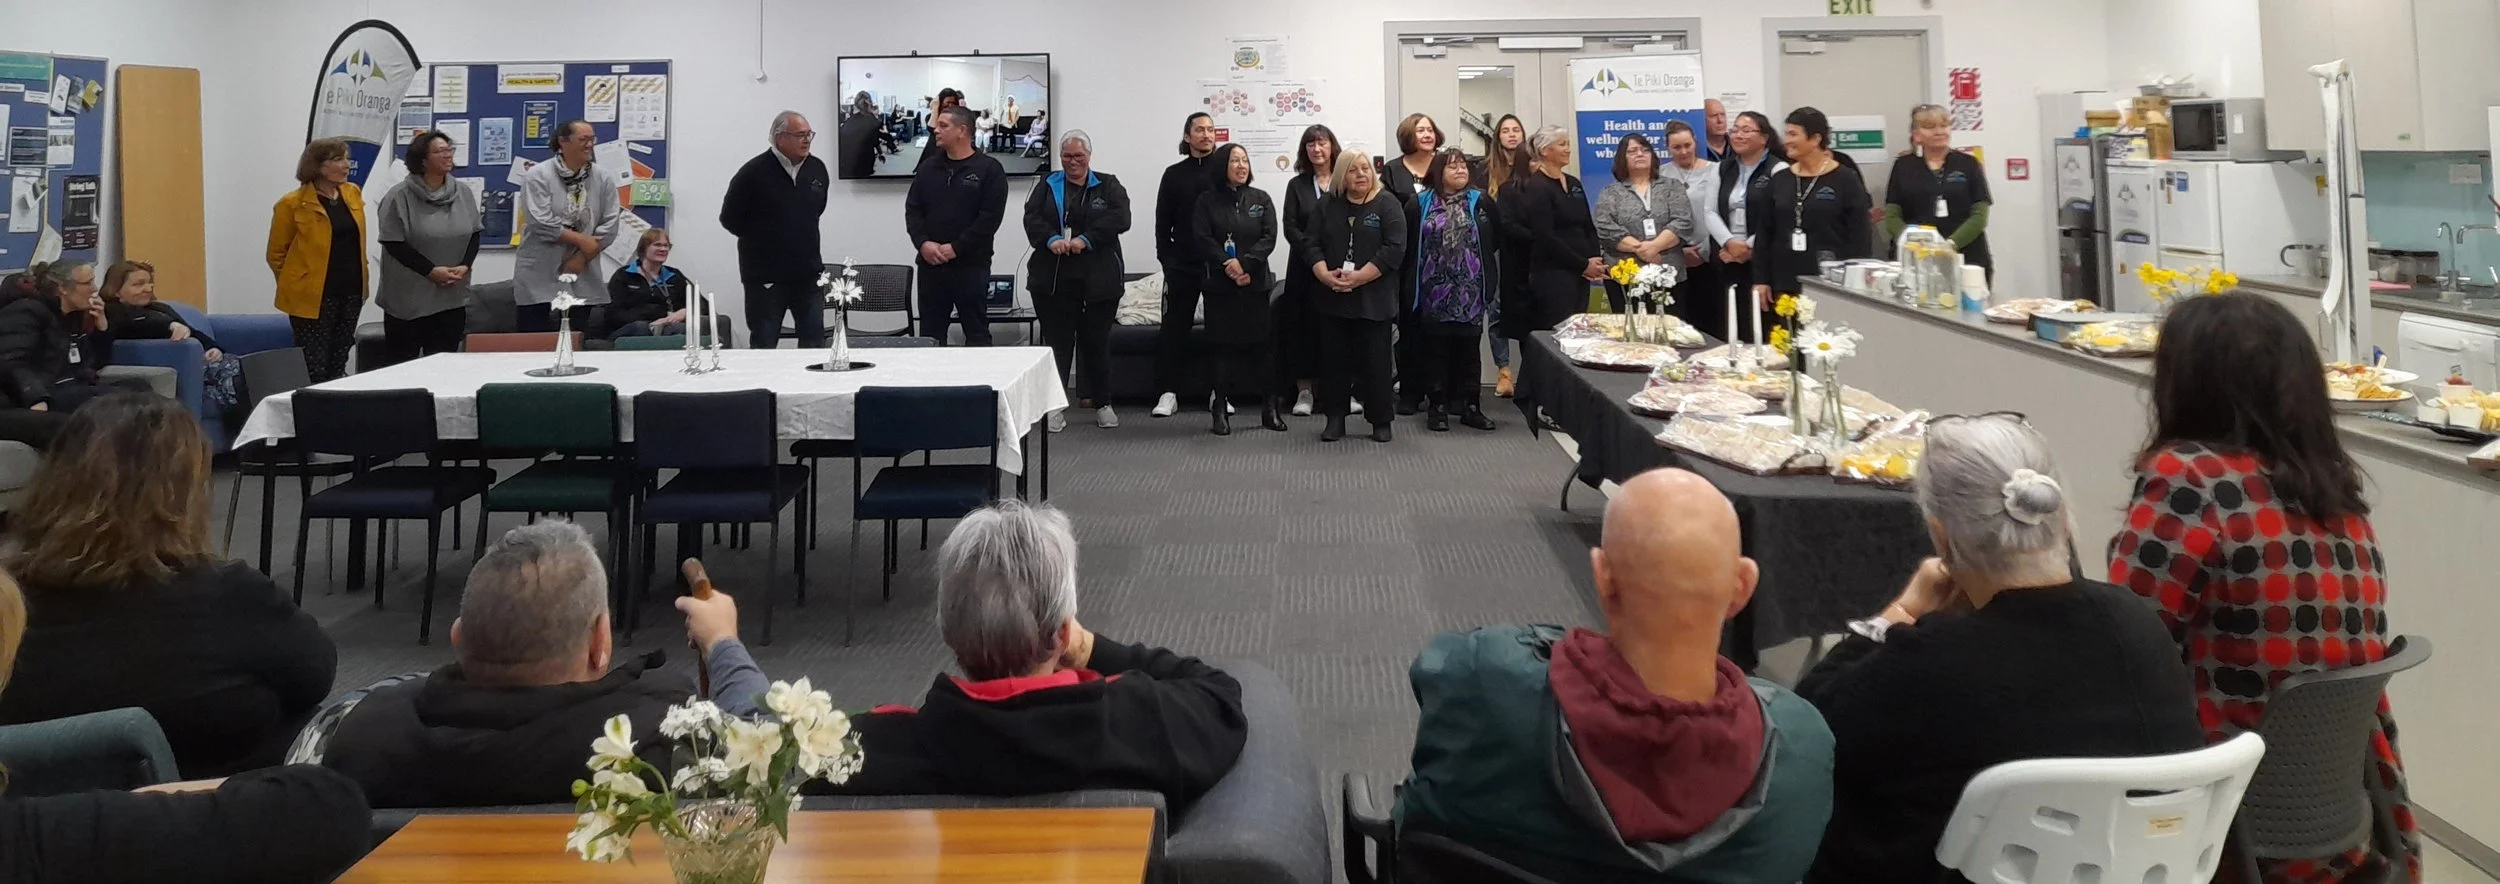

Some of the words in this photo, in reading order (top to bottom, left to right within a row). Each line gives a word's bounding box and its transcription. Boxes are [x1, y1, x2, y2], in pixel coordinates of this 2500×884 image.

[1634, 74, 1643, 86] Te
[1663, 73, 1695, 88] Oranga
[356, 90, 391, 113] Oranga
[1604, 119, 1645, 131] Health
[1838, 133, 1859, 142] Exit
